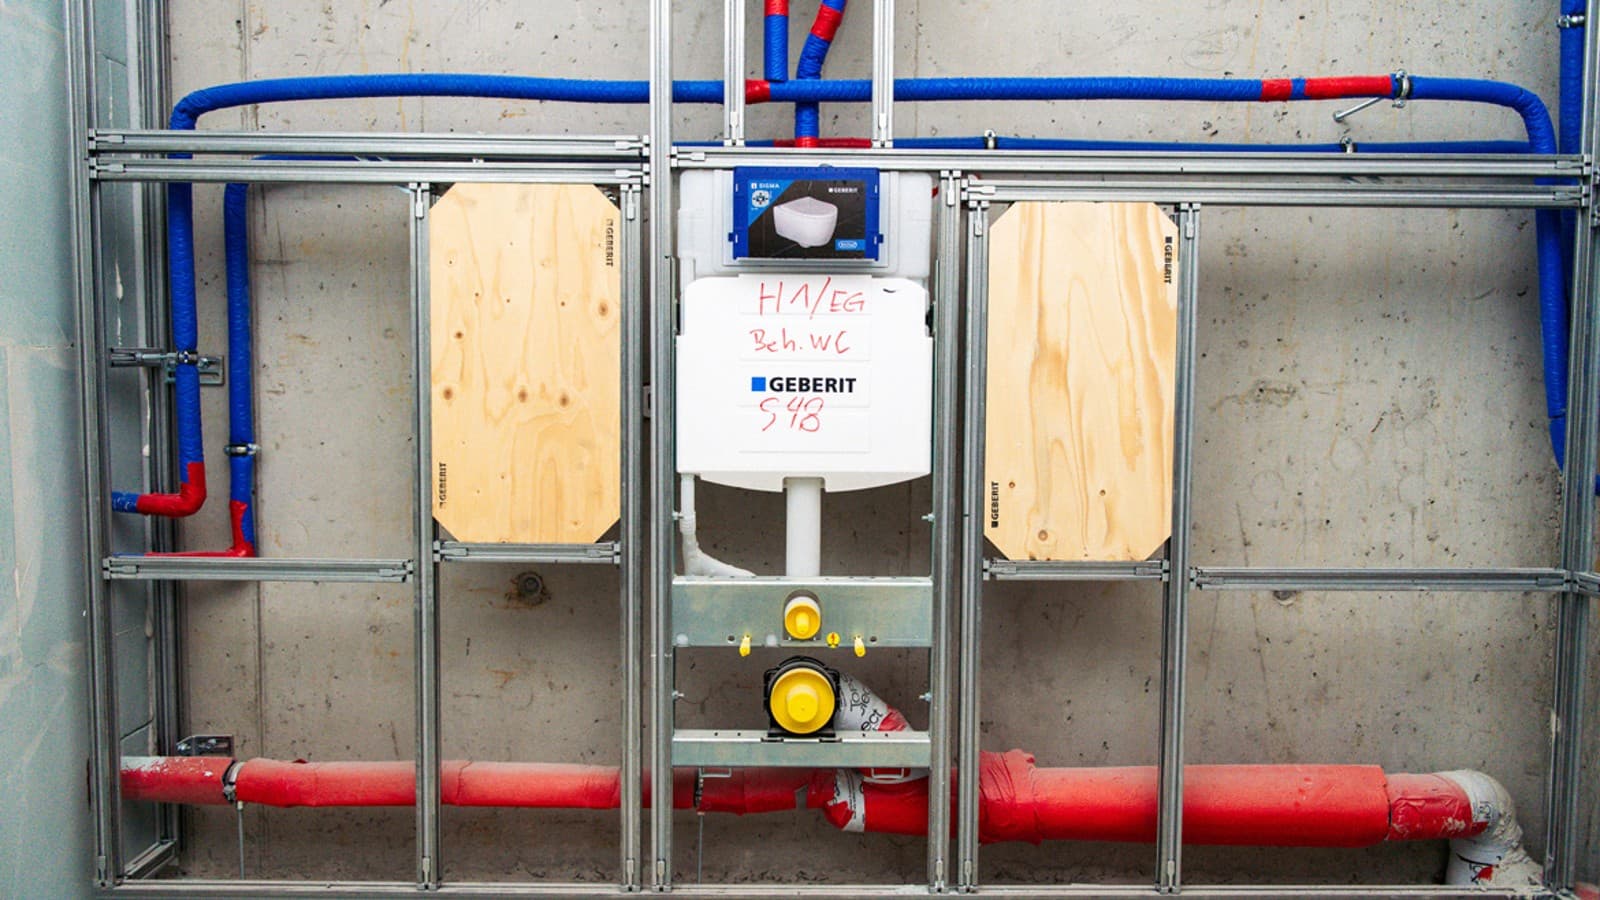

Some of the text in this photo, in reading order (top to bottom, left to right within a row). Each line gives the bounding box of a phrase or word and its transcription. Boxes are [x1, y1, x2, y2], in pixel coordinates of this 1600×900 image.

[605, 227, 614, 267] GEBERIT
[1163, 244, 1173, 285] GEBERIT
[769, 376, 857, 393] GEBERIT
[438, 461, 447, 501] GEBERIT
[990, 481, 999, 520] GEBERIT
